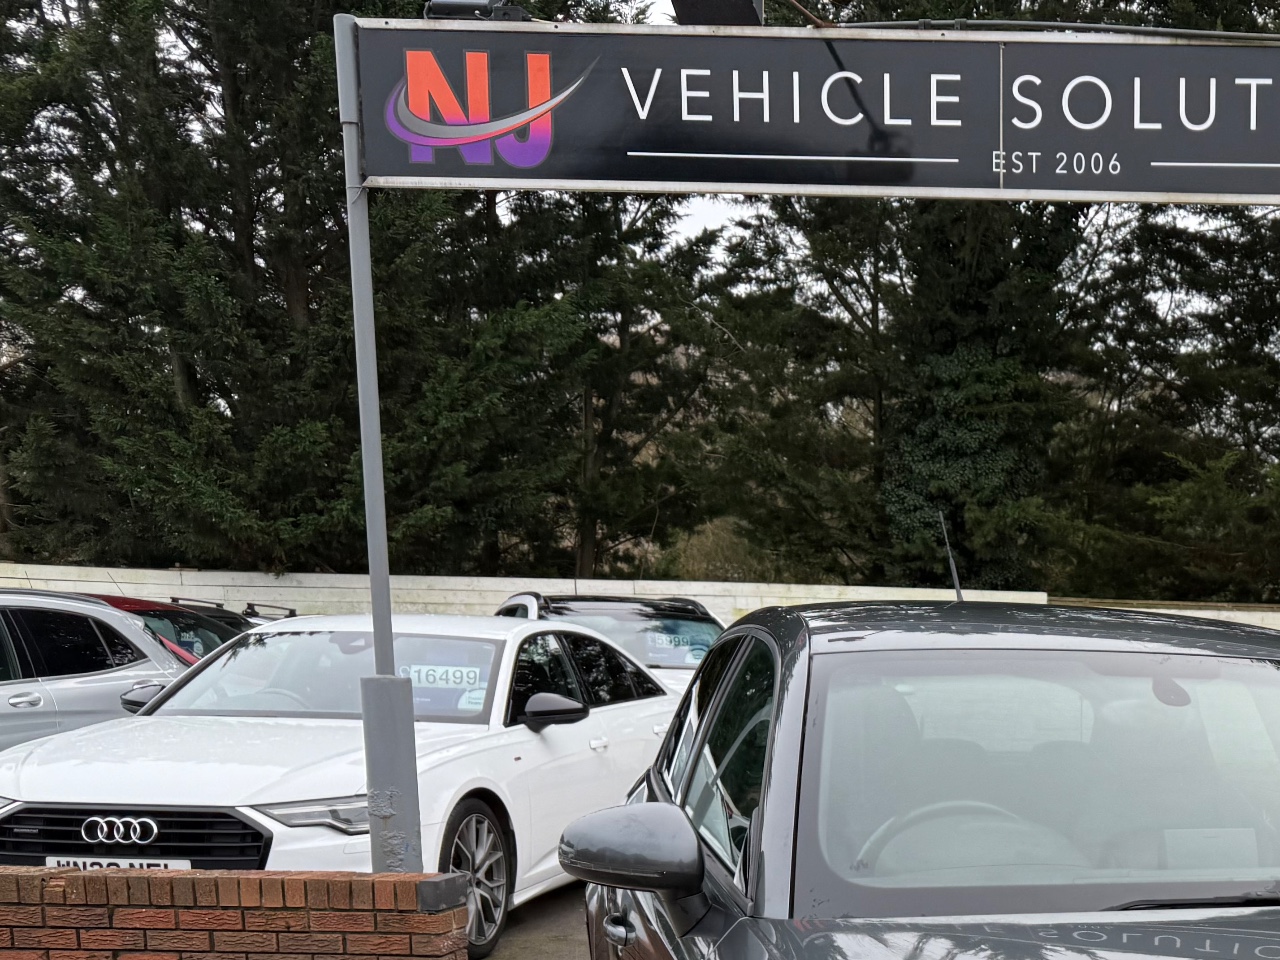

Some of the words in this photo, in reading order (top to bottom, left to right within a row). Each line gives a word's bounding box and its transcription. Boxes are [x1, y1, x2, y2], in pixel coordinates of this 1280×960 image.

[403, 50, 554, 168] NJ
[621, 68, 962, 127] VEHICLE
[992, 150, 1041, 173] EST
[1055, 151, 1122, 175] 2006
